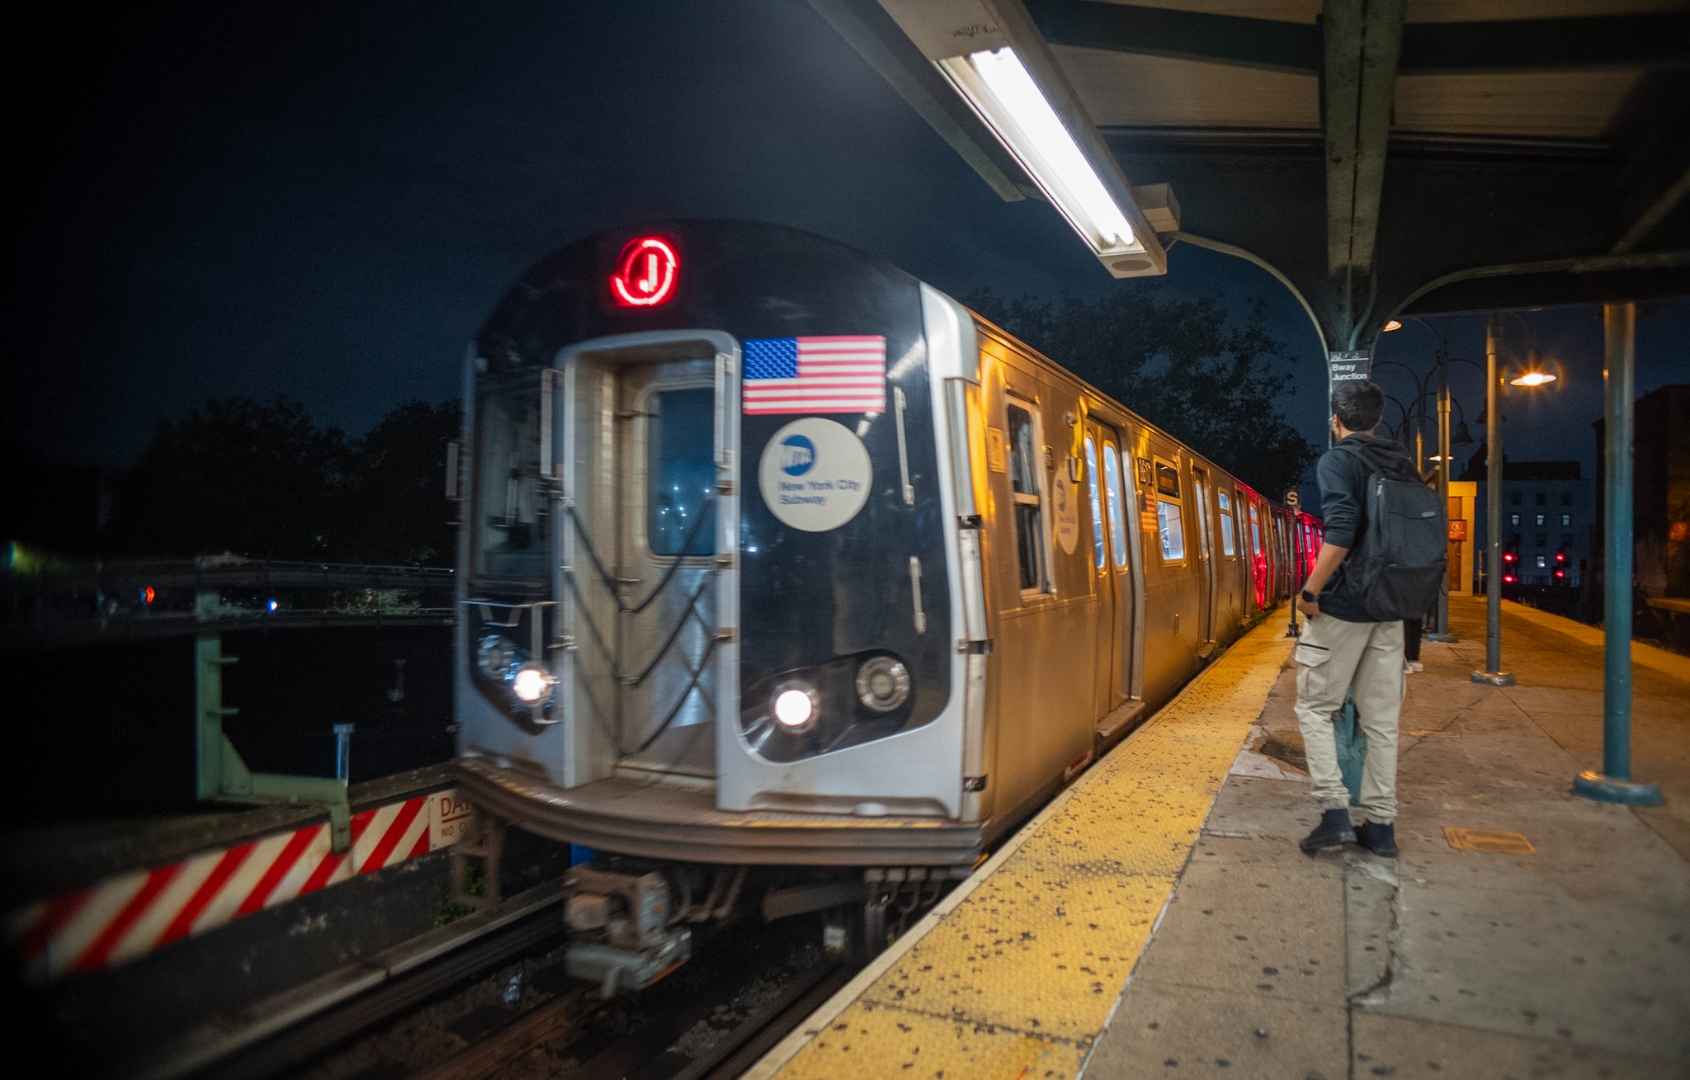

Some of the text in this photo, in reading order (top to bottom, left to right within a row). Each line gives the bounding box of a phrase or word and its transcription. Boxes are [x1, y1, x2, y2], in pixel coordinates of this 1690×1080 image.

[638, 253, 658, 293] J
[1332, 364, 1356, 372] Bway
[1332, 372, 1367, 381] Junction
[778, 480, 861, 491] New York City
[779, 494, 825, 505] Subway
[1287, 491, 1298, 505] S
[442, 825, 454, 838] NO
